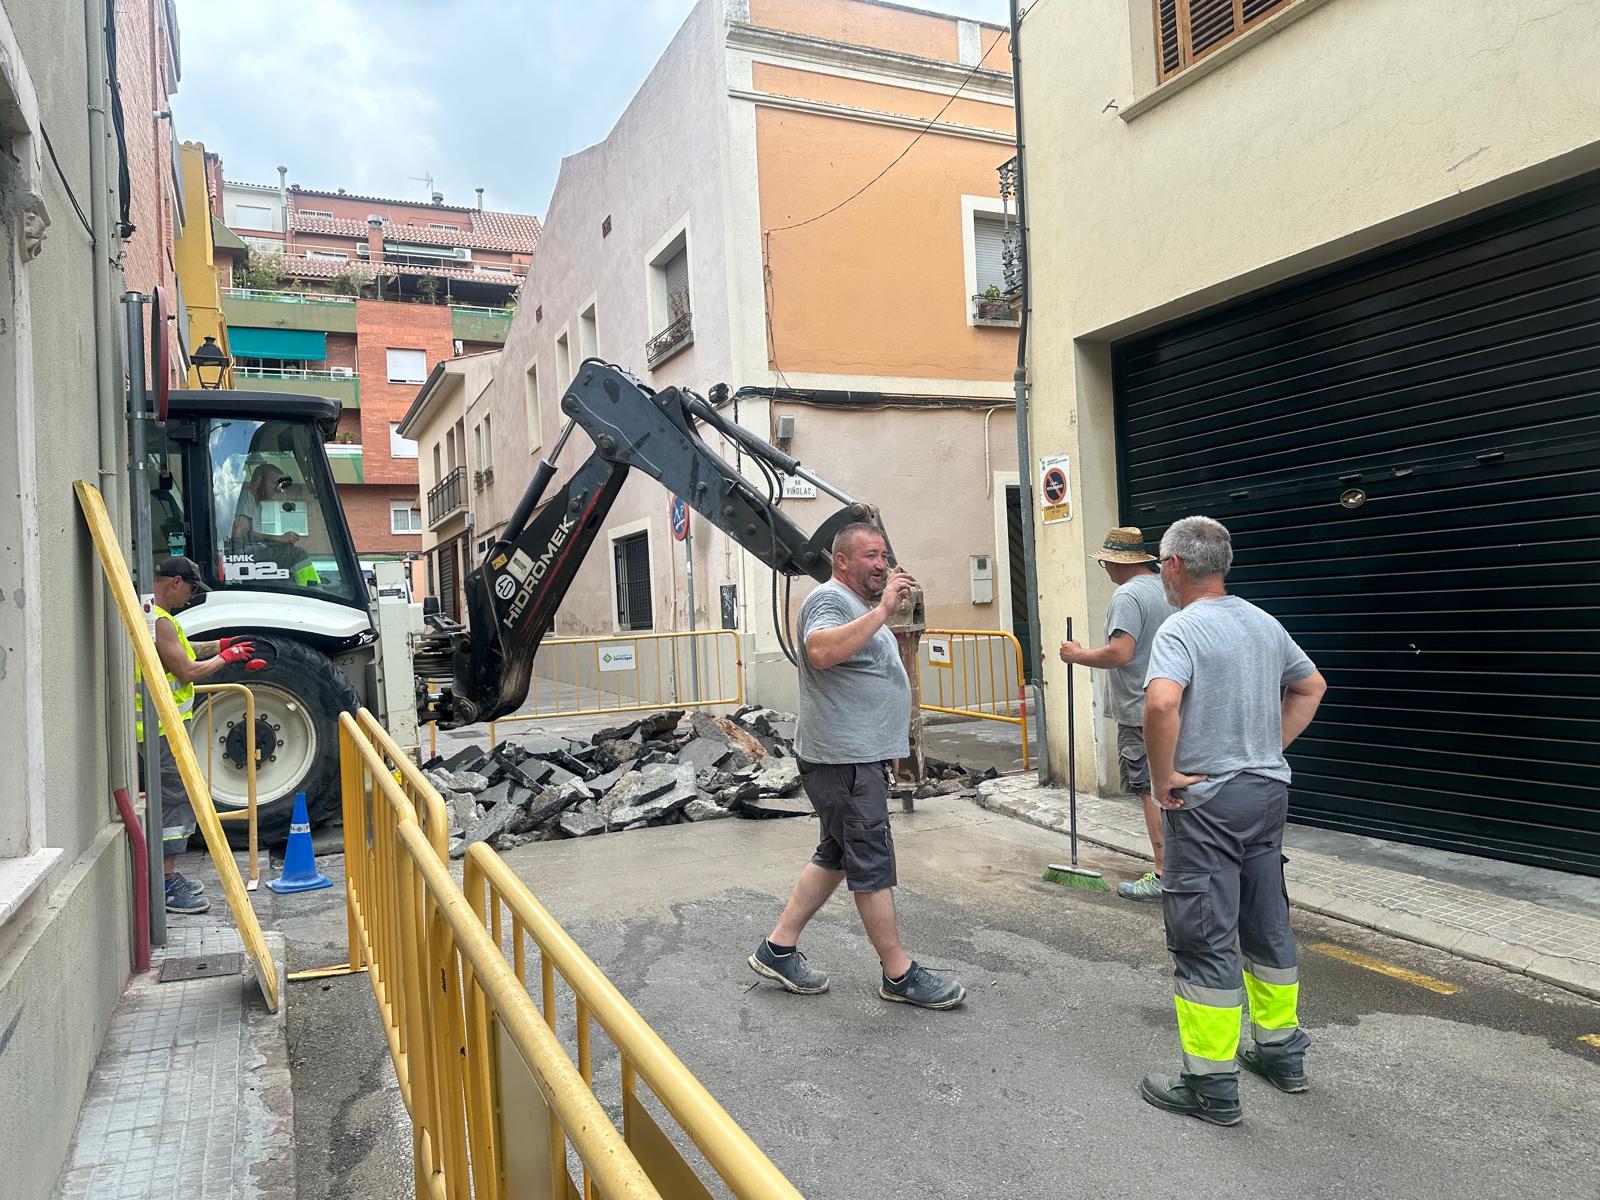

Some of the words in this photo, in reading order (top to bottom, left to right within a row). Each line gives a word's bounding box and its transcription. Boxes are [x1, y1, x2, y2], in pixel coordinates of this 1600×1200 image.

[786, 486, 812, 495] VIÑOLAS
[223, 554, 255, 562] HMK
[498, 577, 513, 597] 40
